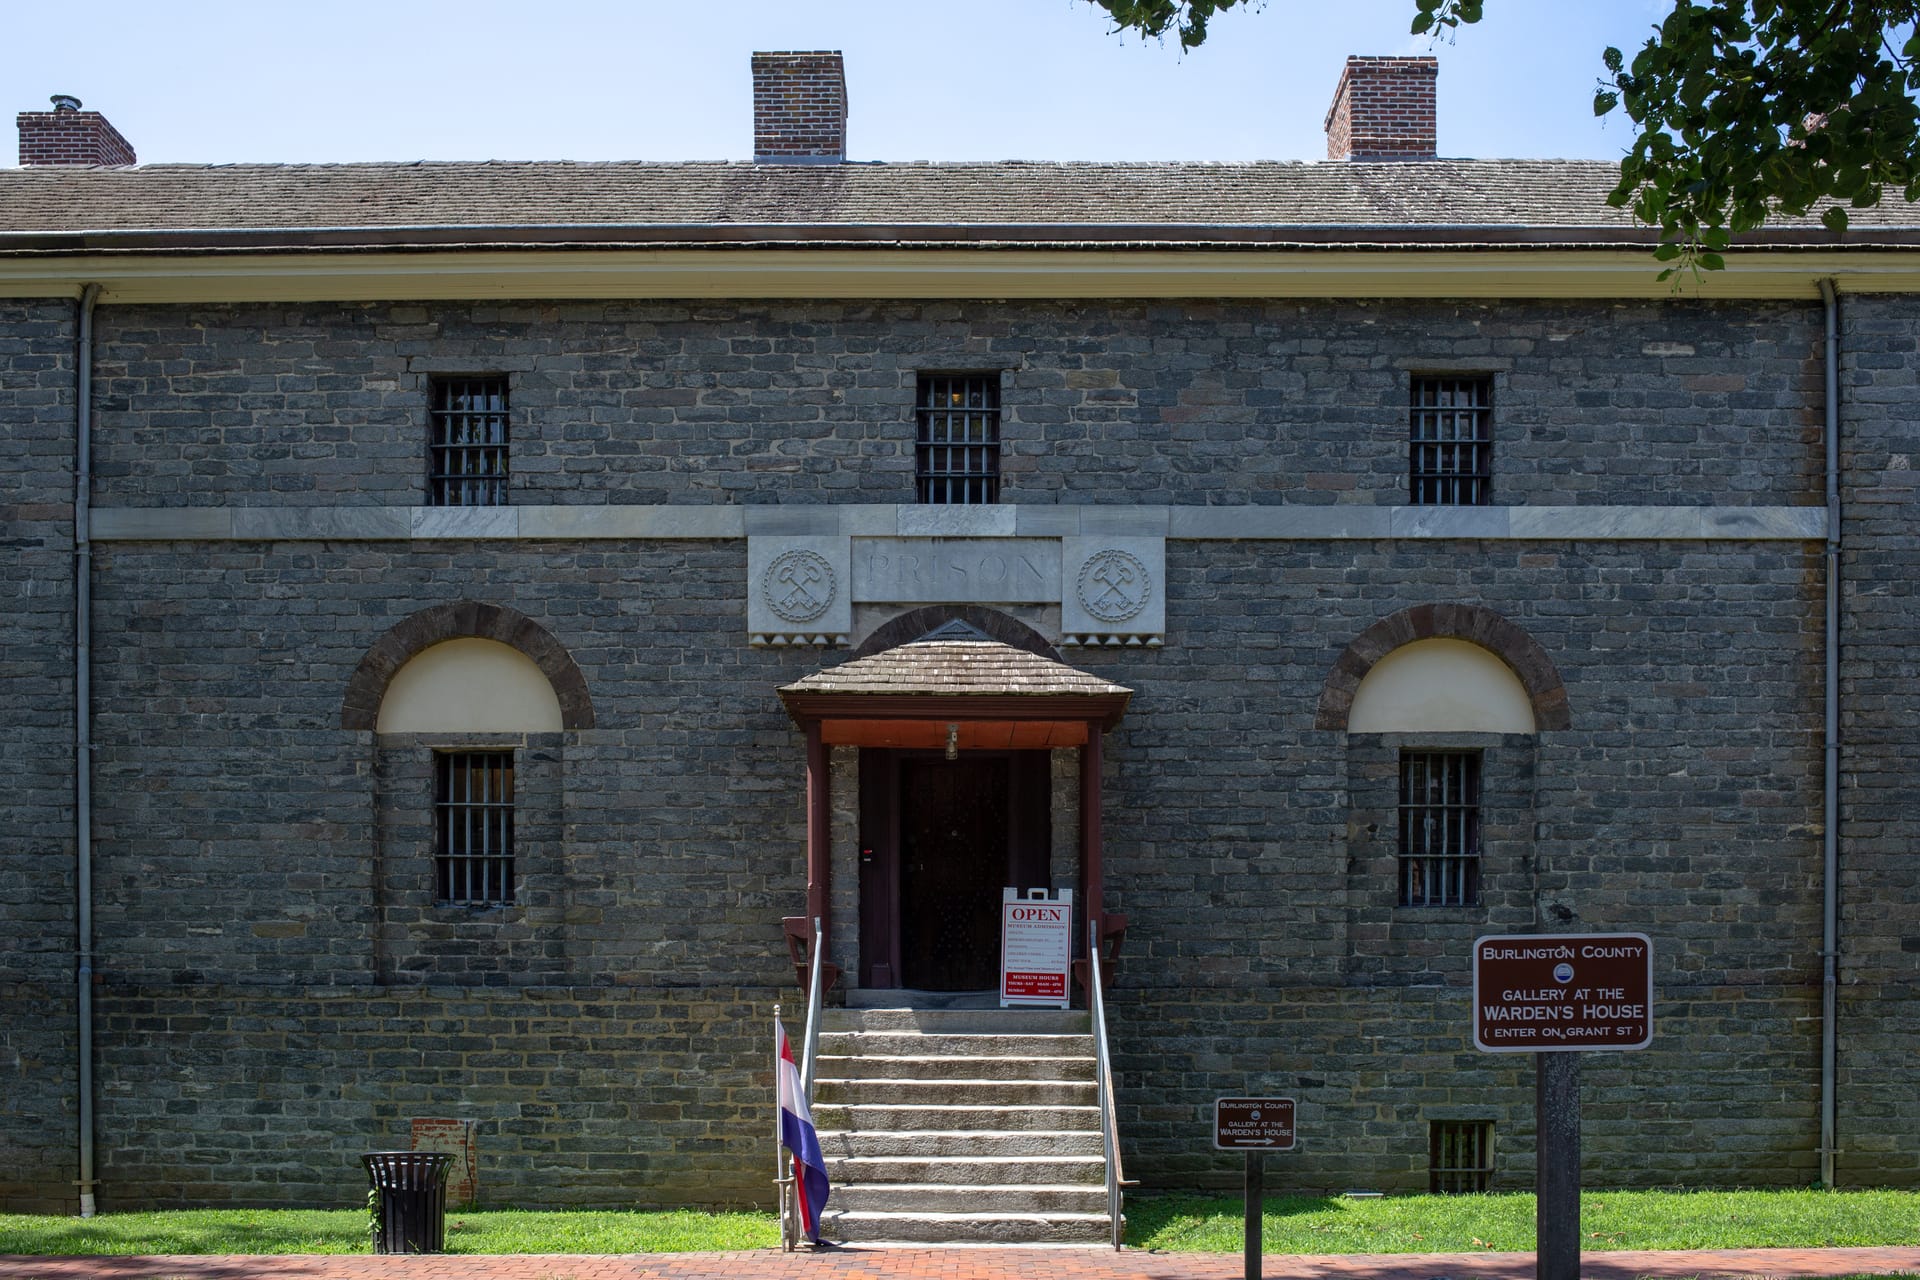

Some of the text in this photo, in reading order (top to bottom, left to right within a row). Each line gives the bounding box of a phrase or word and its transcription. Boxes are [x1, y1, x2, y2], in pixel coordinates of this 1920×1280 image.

[867, 554, 1048, 584] PRISON
[1012, 908, 1062, 921] OPEN
[1483, 945, 1643, 960] BURLINGTON COUNTY
[1502, 988, 1625, 1001] GALLERY AT THE
[1484, 1004, 1644, 1020] WARDEN'S HOUSE
[1494, 1028, 1536, 1038] ENTER
[1542, 1028, 1560, 1038] ON
[1566, 1027, 1611, 1037] GRANT
[1616, 1026, 1633, 1036] ST
[1220, 1128, 1293, 1136] WARDEN'S HOUSE
